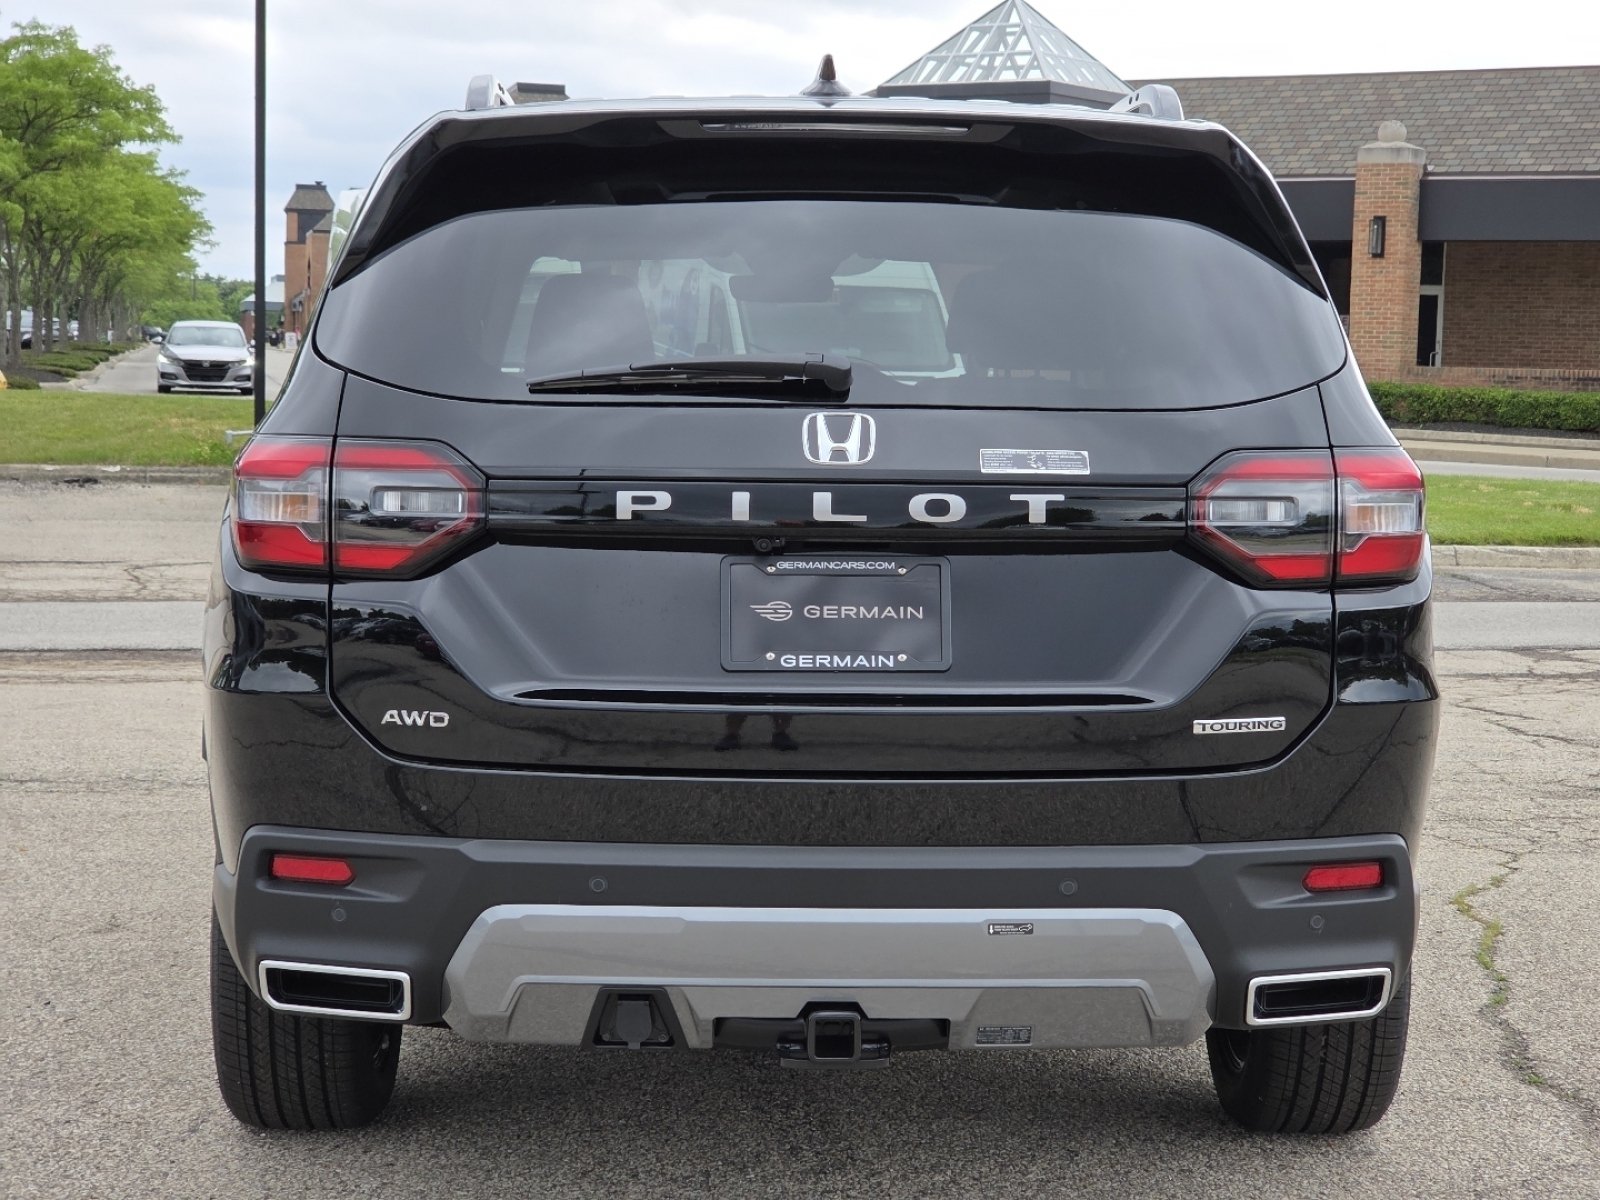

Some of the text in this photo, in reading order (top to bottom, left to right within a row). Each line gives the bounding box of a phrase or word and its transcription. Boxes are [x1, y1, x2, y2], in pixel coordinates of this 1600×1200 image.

[616, 490, 1065, 524] PILOT
[776, 560, 896, 571] GERMAINCARS.COM
[803, 604, 924, 620] GERMAIN
[780, 654, 894, 668] GERMAIN
[381, 709, 450, 728] AWD
[1199, 719, 1284, 732] TOURING
